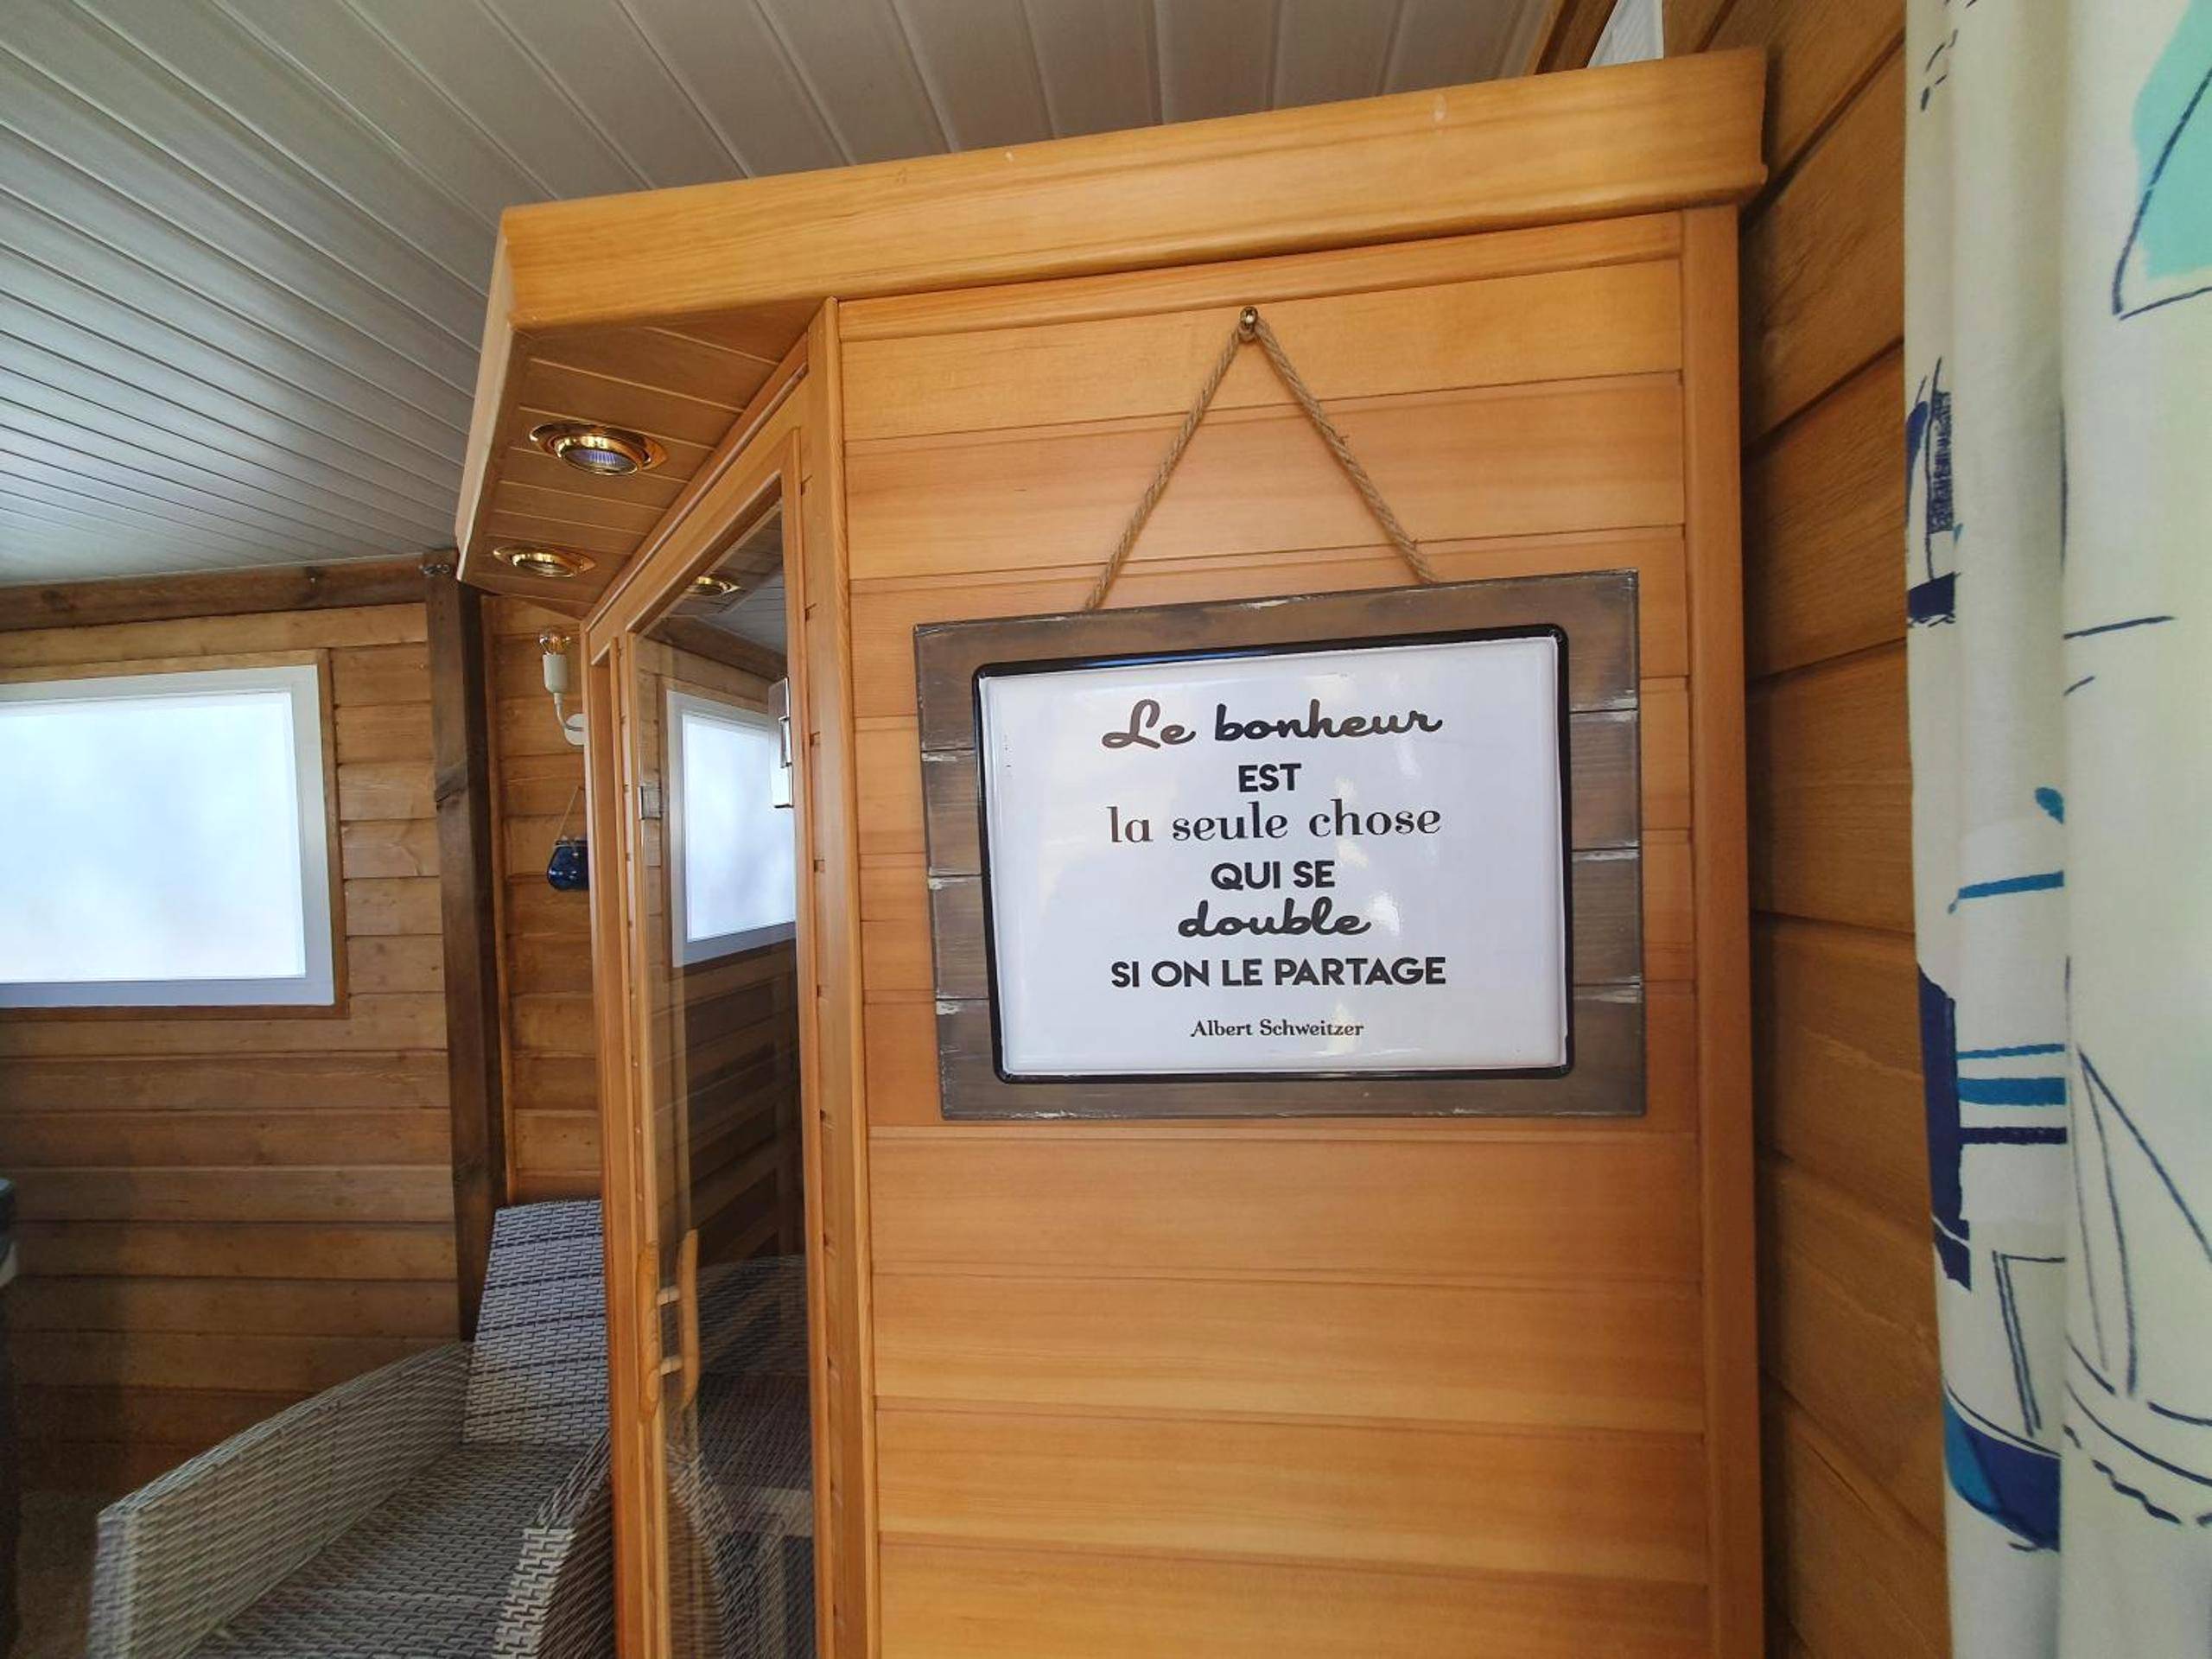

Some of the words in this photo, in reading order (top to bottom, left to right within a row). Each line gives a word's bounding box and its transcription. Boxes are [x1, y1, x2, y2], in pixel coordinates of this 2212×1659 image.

[1102, 698, 1197, 749] Le
[1214, 698, 1443, 741] bonheur
[1238, 762, 1302, 792] EST
[1107, 805, 1153, 843] la
[1172, 800, 1289, 842] seule
[1308, 798, 1442, 837] chose
[1210, 861, 1281, 891] QUI
[1293, 860, 1336, 888] SE
[1177, 896, 1372, 938] double
[1111, 960, 1140, 988] SI
[1151, 959, 1210, 988] ON
[1222, 958, 1263, 987] LE
[1274, 956, 1446, 986] PARTAGE
[1190, 1019, 1253, 1038] Albert
[1259, 1018, 1364, 1037] Schweitzer
